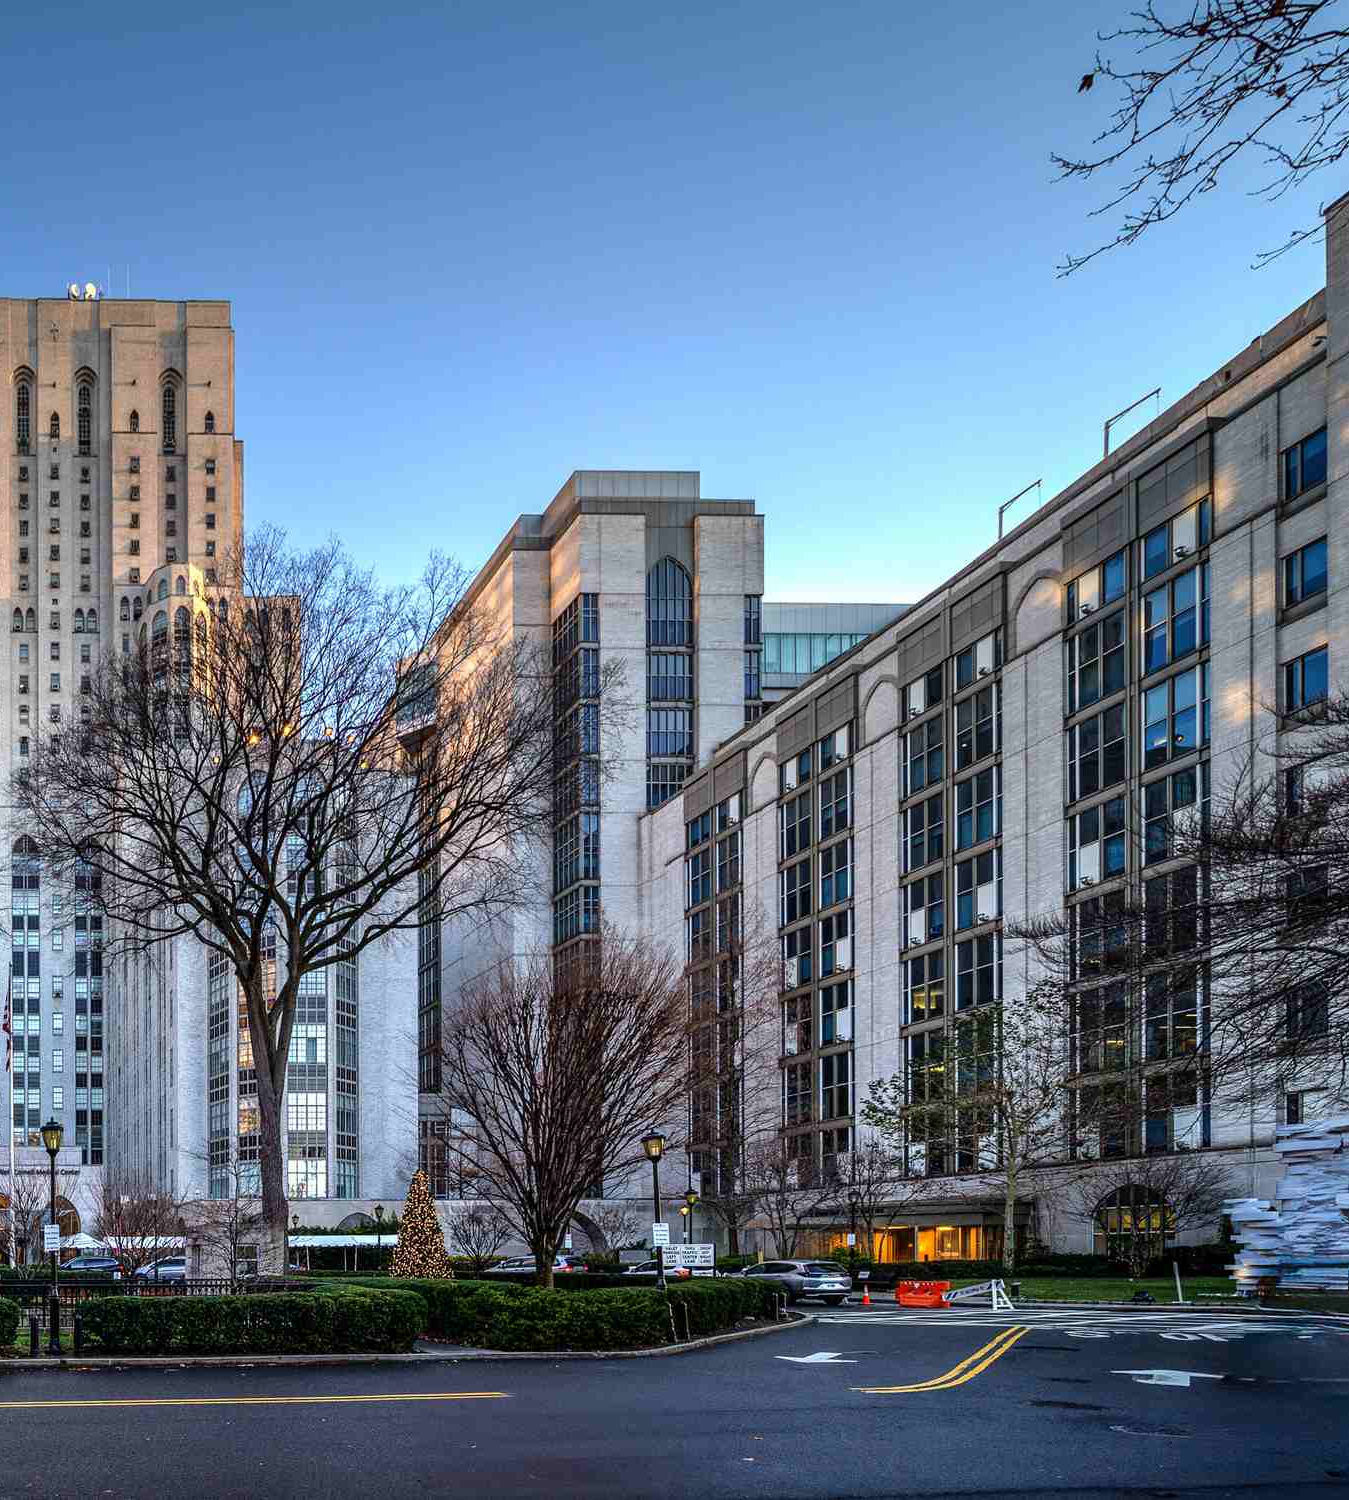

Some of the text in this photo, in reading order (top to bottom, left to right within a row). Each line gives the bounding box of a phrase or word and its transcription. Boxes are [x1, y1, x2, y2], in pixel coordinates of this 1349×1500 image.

[14, 1168, 35, 1176] Cornell
[36, 1168, 60, 1176] Medal
[60, 1168, 80, 1176] Center
